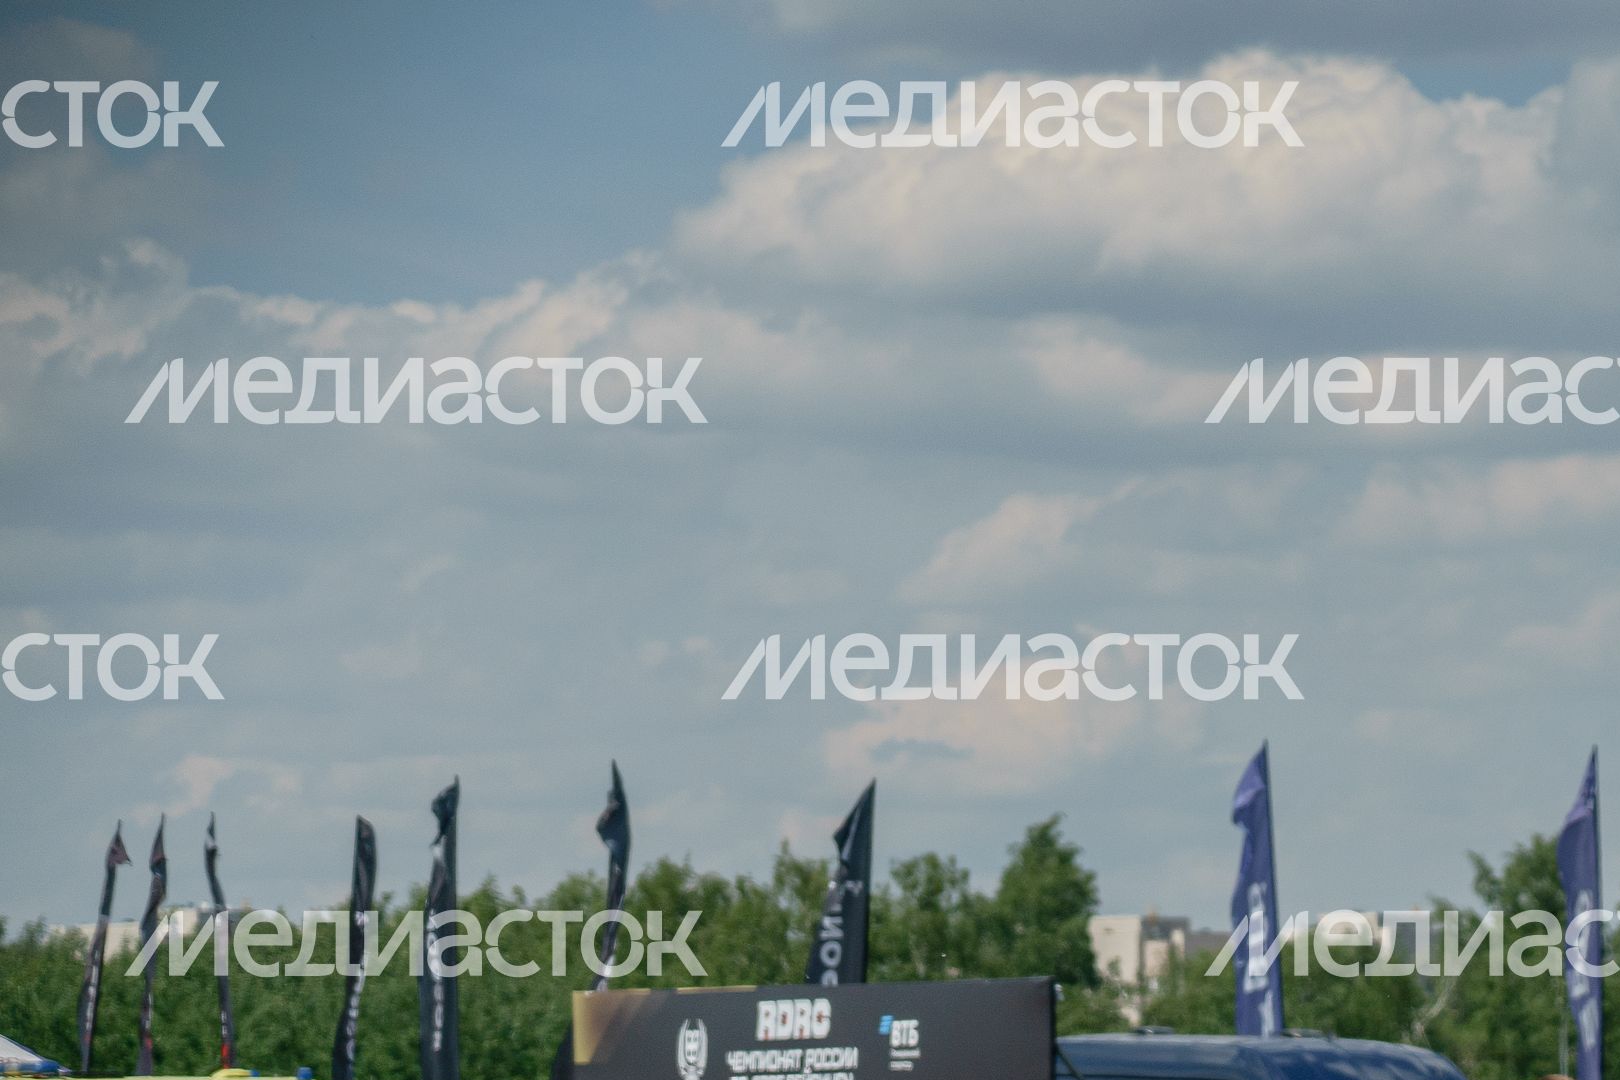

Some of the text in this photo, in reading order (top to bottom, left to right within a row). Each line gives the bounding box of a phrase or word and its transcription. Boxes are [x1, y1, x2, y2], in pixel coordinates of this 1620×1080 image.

[756, 998, 831, 1041] RDRC
[889, 1019, 919, 1048] ВТБ
[726, 1047, 859, 1074] ЧЕМПИОНАТ РОССИИ
